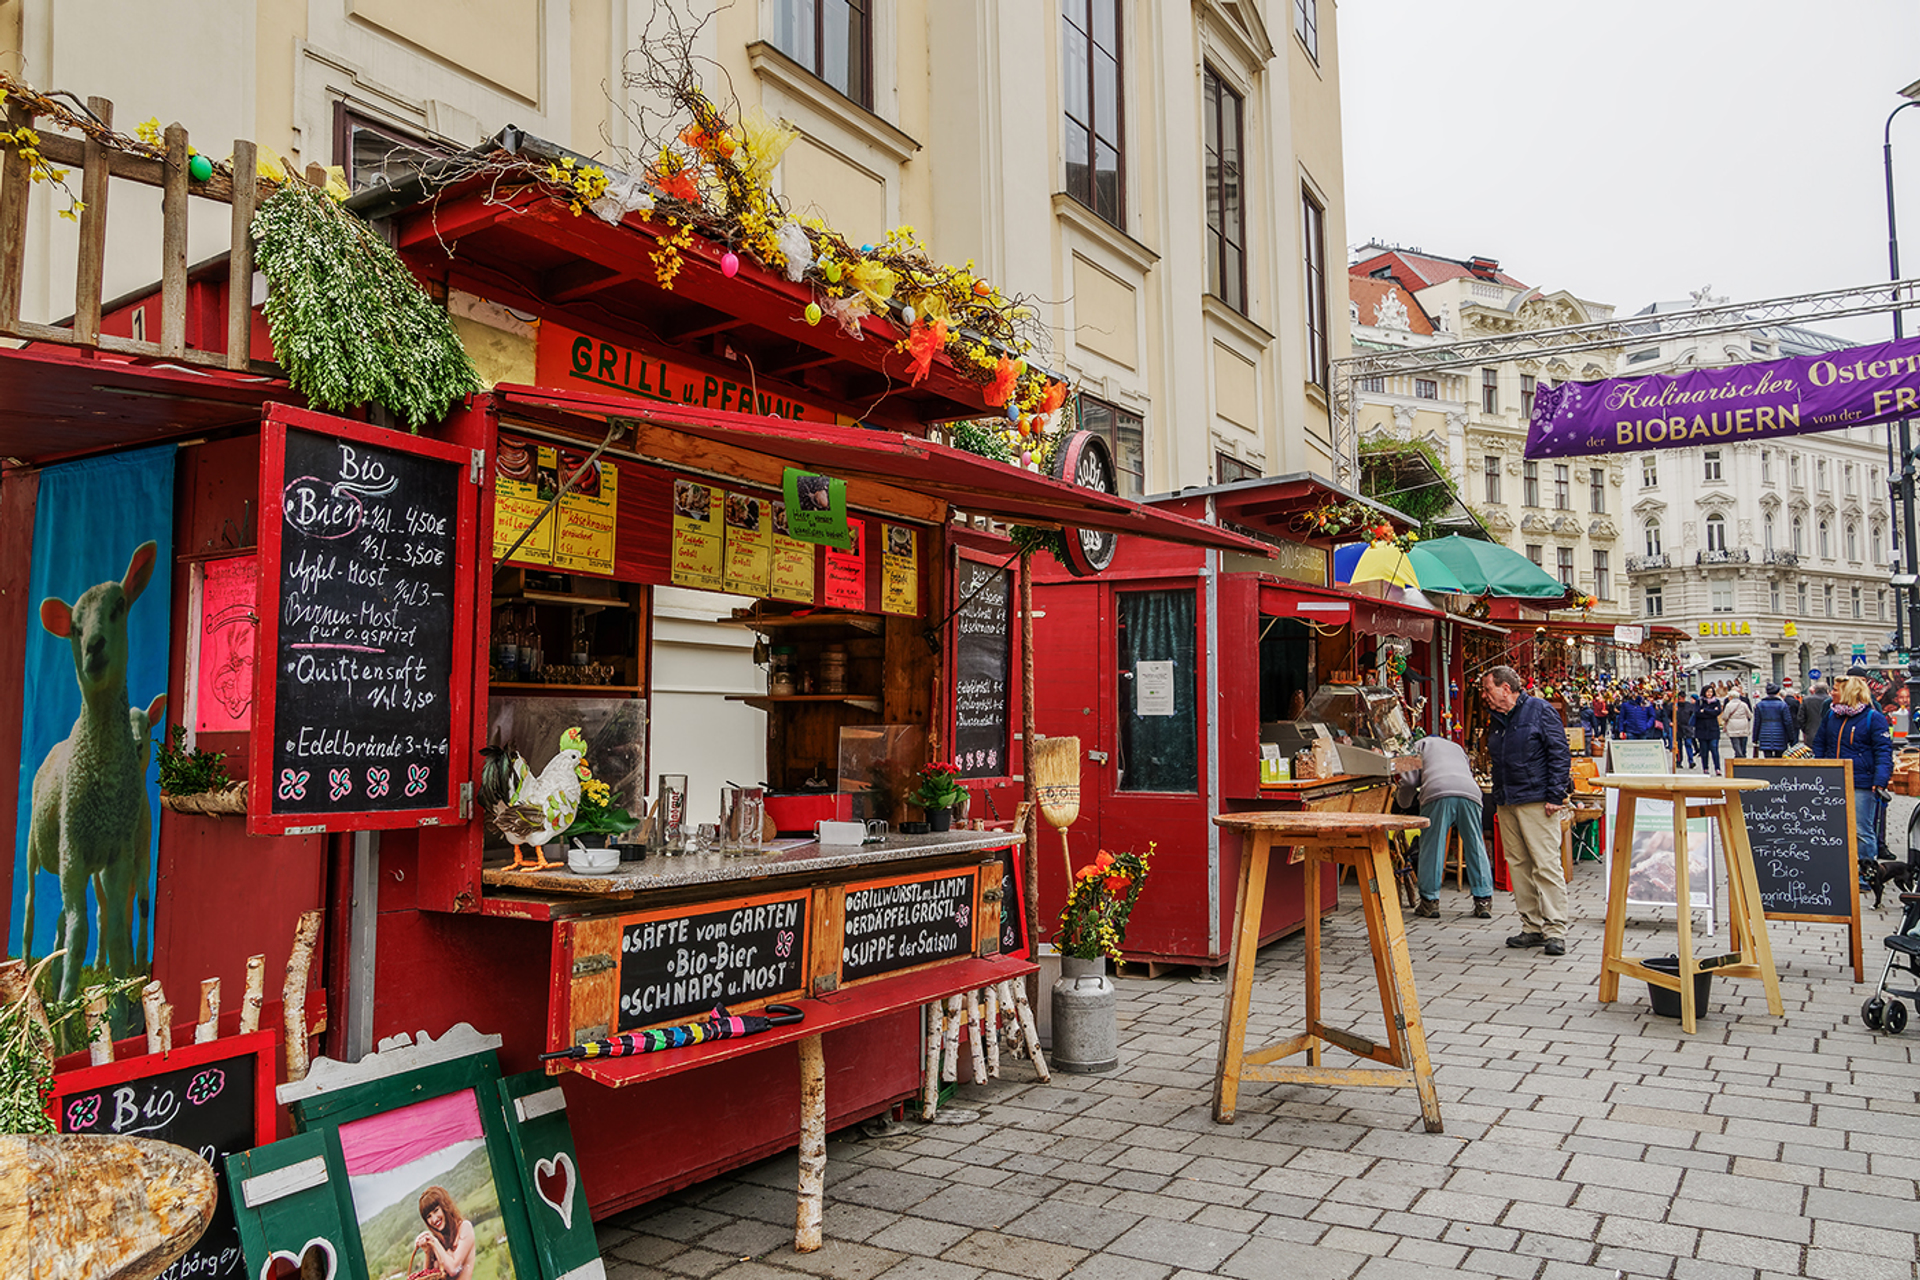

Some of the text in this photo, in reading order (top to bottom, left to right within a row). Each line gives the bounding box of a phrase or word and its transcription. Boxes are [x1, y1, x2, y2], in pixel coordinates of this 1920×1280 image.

[571, 336, 672, 398] GRILL
[1604, 370, 1798, 411] Kulinarischer
[1586, 435, 1606, 449] der
[1616, 404, 1800, 445] BIOBAUERN
[1812, 413, 1837, 425] von
[1839, 408, 1862, 421] der
[338, 443, 385, 481] Bio
[309, 624, 340, 642] pur
[1699, 621, 1752, 636] BILLA
[296, 654, 427, 692] Quittensaft
[1757, 820, 1827, 836] Bio Schwein
[1799, 806, 1828, 822] Brot
[1753, 843, 1811, 861] Frisches
[932, 877, 967, 900] LAMM
[630, 902, 798, 953] SÄFTE vom GARTEN
[674, 940, 758, 978] Bio-Bier
[849, 929, 958, 968] SUPPE der Saison
[629, 971, 725, 1016] SCHNAPS
[742, 961, 787, 994] MOST
[110, 1085, 175, 1132] Bio
